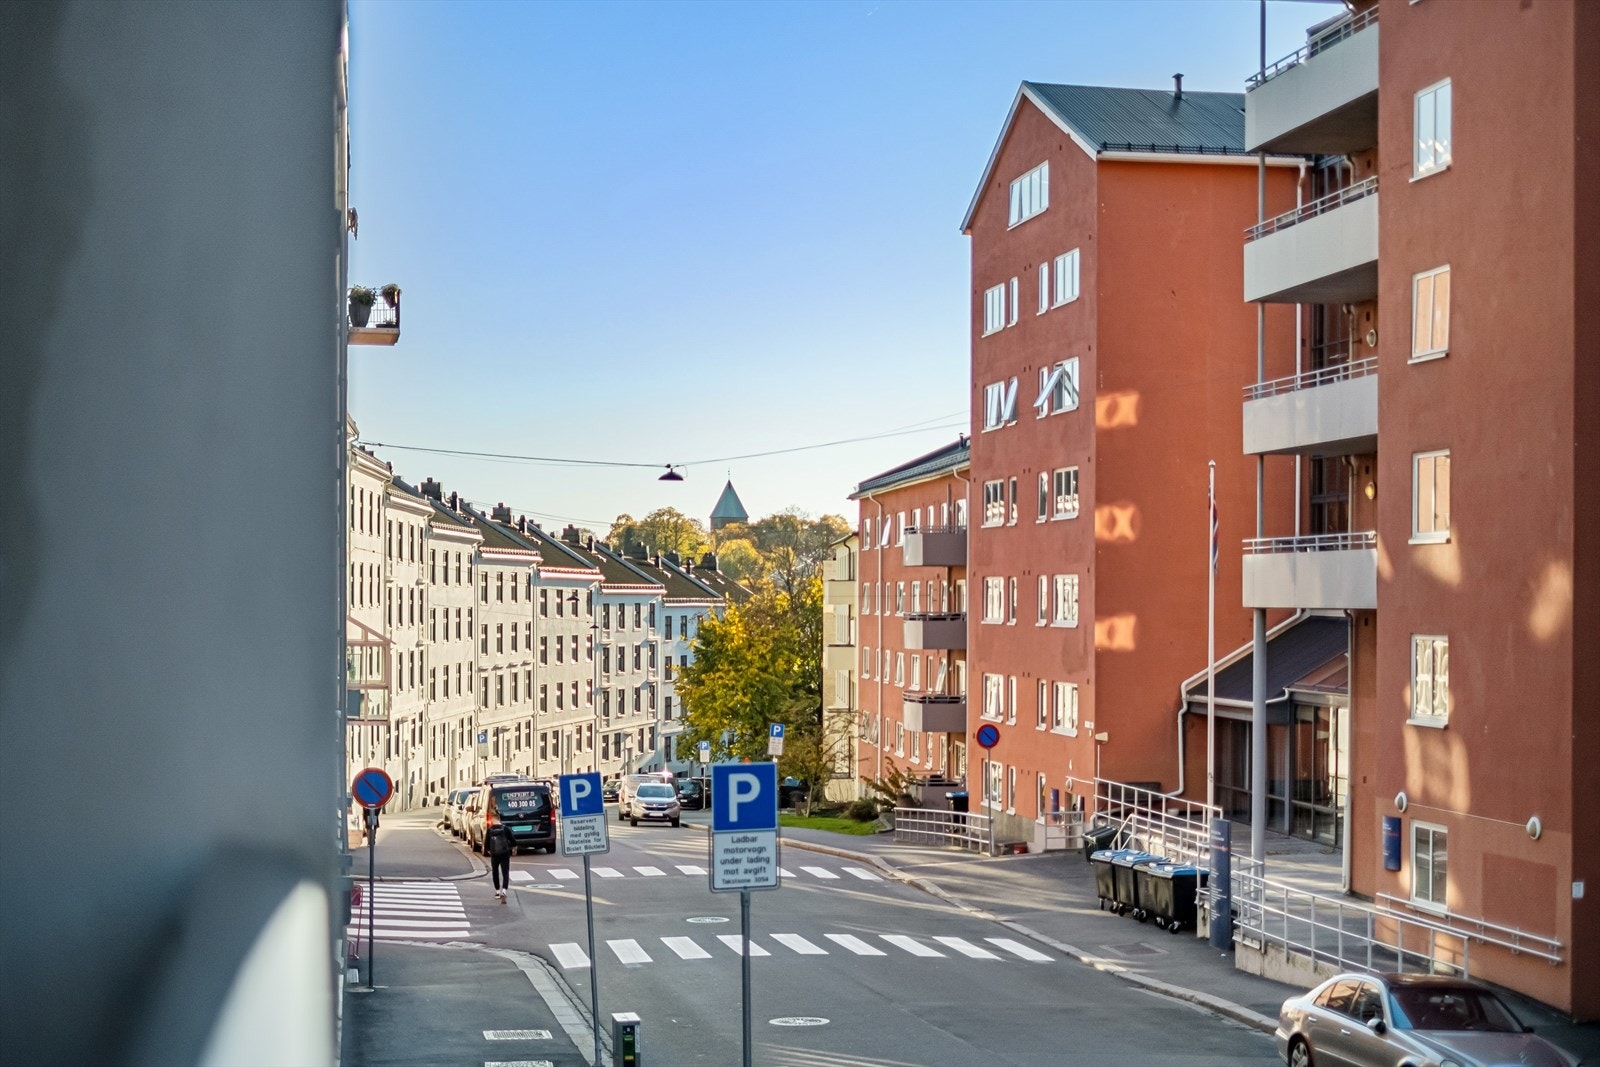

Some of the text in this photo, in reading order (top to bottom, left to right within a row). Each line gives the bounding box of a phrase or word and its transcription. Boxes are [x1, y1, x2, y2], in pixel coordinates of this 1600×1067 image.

[773, 725, 781, 736] P
[479, 734, 485, 742] P
[569, 779, 591, 811] P
[729, 773, 760, 822] P
[519, 800, 529, 808] 300
[570, 817, 597, 825] Reservert
[583, 831, 600, 839] gyldig
[731, 835, 758, 844] Ladbar
[723, 846, 767, 855] motorvogn
[720, 856, 770, 865] under lading
[723, 865, 766, 876] mot avgift
